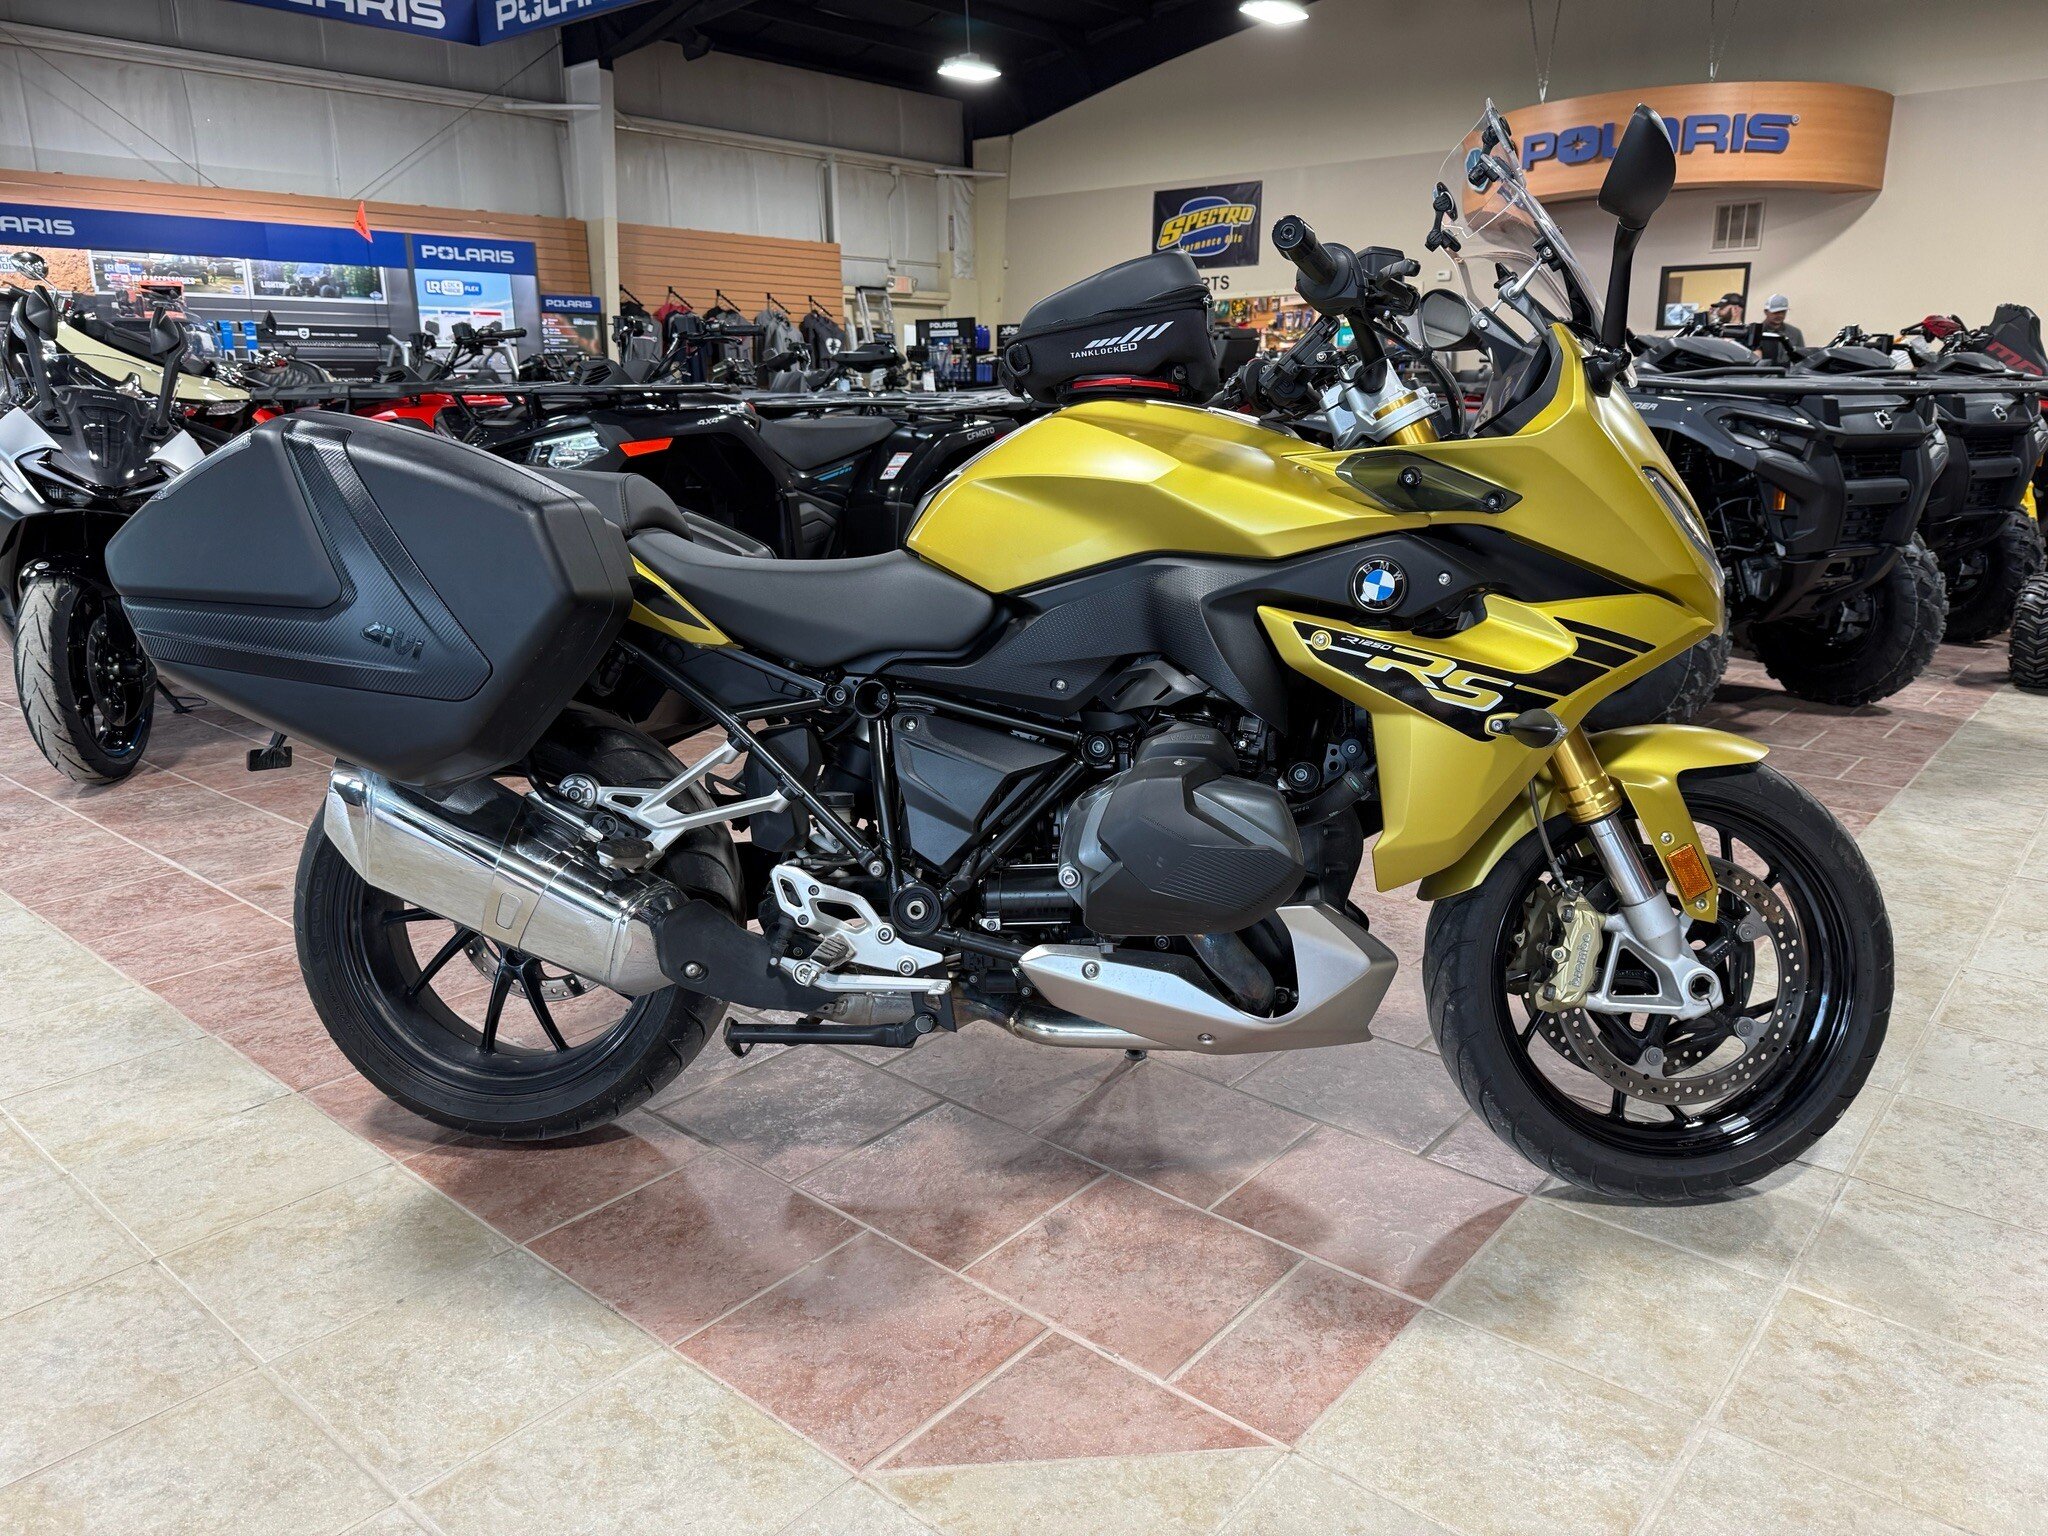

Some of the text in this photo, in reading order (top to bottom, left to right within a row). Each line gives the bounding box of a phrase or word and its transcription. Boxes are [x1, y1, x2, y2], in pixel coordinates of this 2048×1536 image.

[1157, 205, 1256, 250] SPECTRO
[421, 244, 515, 264] POLARIS
[545, 299, 593, 308] POLARIS
[929, 321, 958, 329] POLARIS
[1070, 342, 1138, 359] TANKLOCKED
[1633, 401, 1659, 411] DER
[697, 417, 719, 426] 4X4
[966, 426, 995, 441] CFMOTO
[1362, 560, 1404, 582] BMW
[1364, 647, 1514, 712] RS
[1567, 932, 1591, 987] brembo
